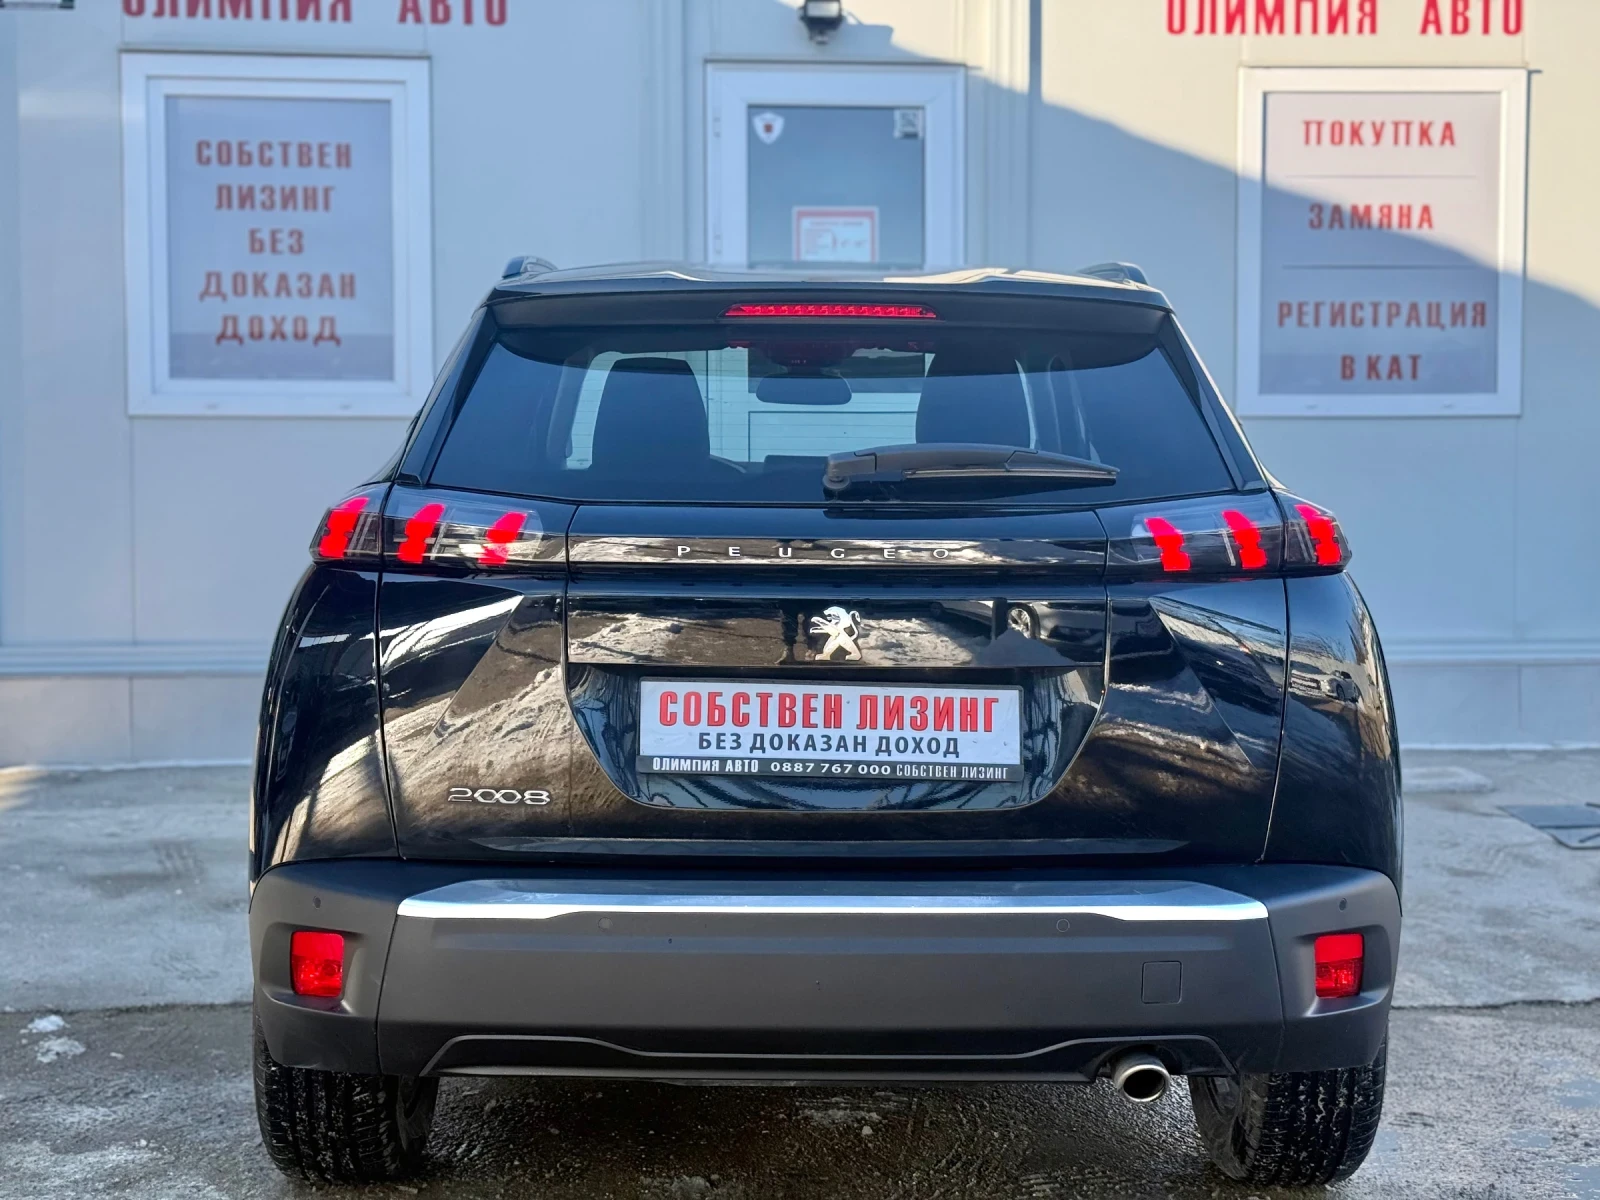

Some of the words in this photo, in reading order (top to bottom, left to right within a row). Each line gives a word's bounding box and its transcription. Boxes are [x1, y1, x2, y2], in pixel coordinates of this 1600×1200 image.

[1165, 0, 1378, 35] ОЛИМПИЯ
[1418, 0, 1524, 35] АВТО
[1302, 120, 1457, 147] ПОКУПКА
[195, 140, 353, 169] СОБСТВЕН
[215, 184, 336, 212] ЛИЗИНГ
[1308, 203, 1434, 230] ЗАМЯНА
[248, 228, 306, 255] БЕЗ
[200, 271, 357, 302] ДОКАЗАН
[1278, 301, 1488, 331] РЕГИСТРАЦИЯ
[215, 315, 342, 347] ДОХОД
[1366, 354, 1422, 381] КАТ
[658, 690, 843, 729] СОБСТВЕН
[855, 694, 1000, 733] ЛИЗИНГ
[698, 732, 742, 750] БЕЗ
[749, 733, 867, 754] ДОКАЗАН
[874, 736, 960, 758] ДОХОД
[652, 757, 720, 772] ОЛИМПИЯ
[725, 759, 759, 773] АВТО
[770, 761, 815, 773] 0887
[820, 762, 853, 774] 767
[858, 764, 891, 775] 000
[896, 764, 957, 778] СОБСТВЕН
[961, 766, 1009, 780] ЛИЗИНГ
[447, 787, 550, 805] 2008
